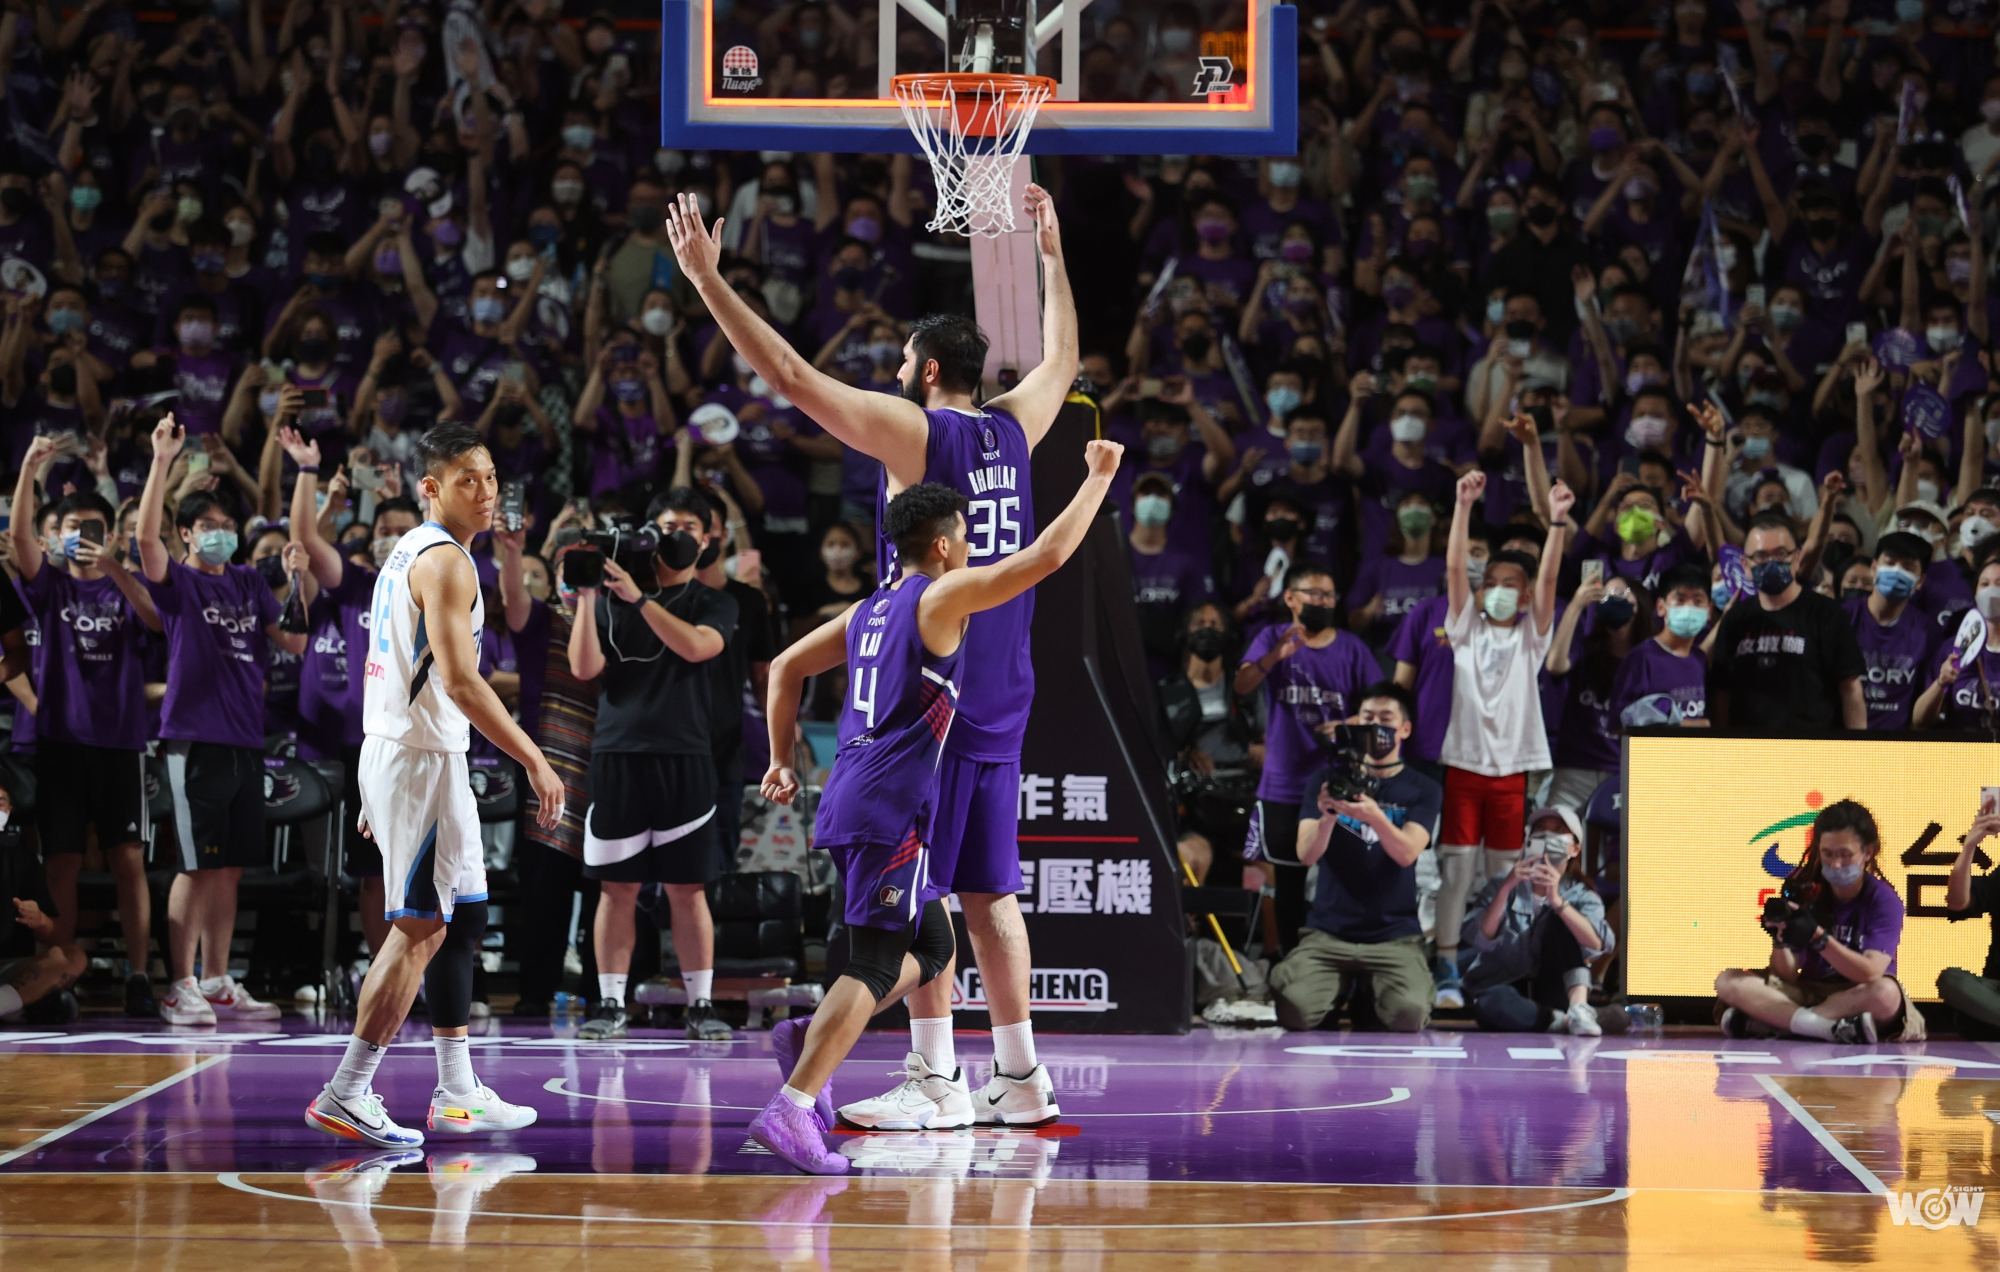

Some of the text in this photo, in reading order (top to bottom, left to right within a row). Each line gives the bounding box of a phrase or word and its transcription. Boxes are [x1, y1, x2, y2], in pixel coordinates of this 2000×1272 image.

[968, 465, 1017, 495] BHULLAR
[968, 496, 1021, 557] 35
[854, 667, 878, 728] 4
[968, 973, 1103, 1001] FHENG
